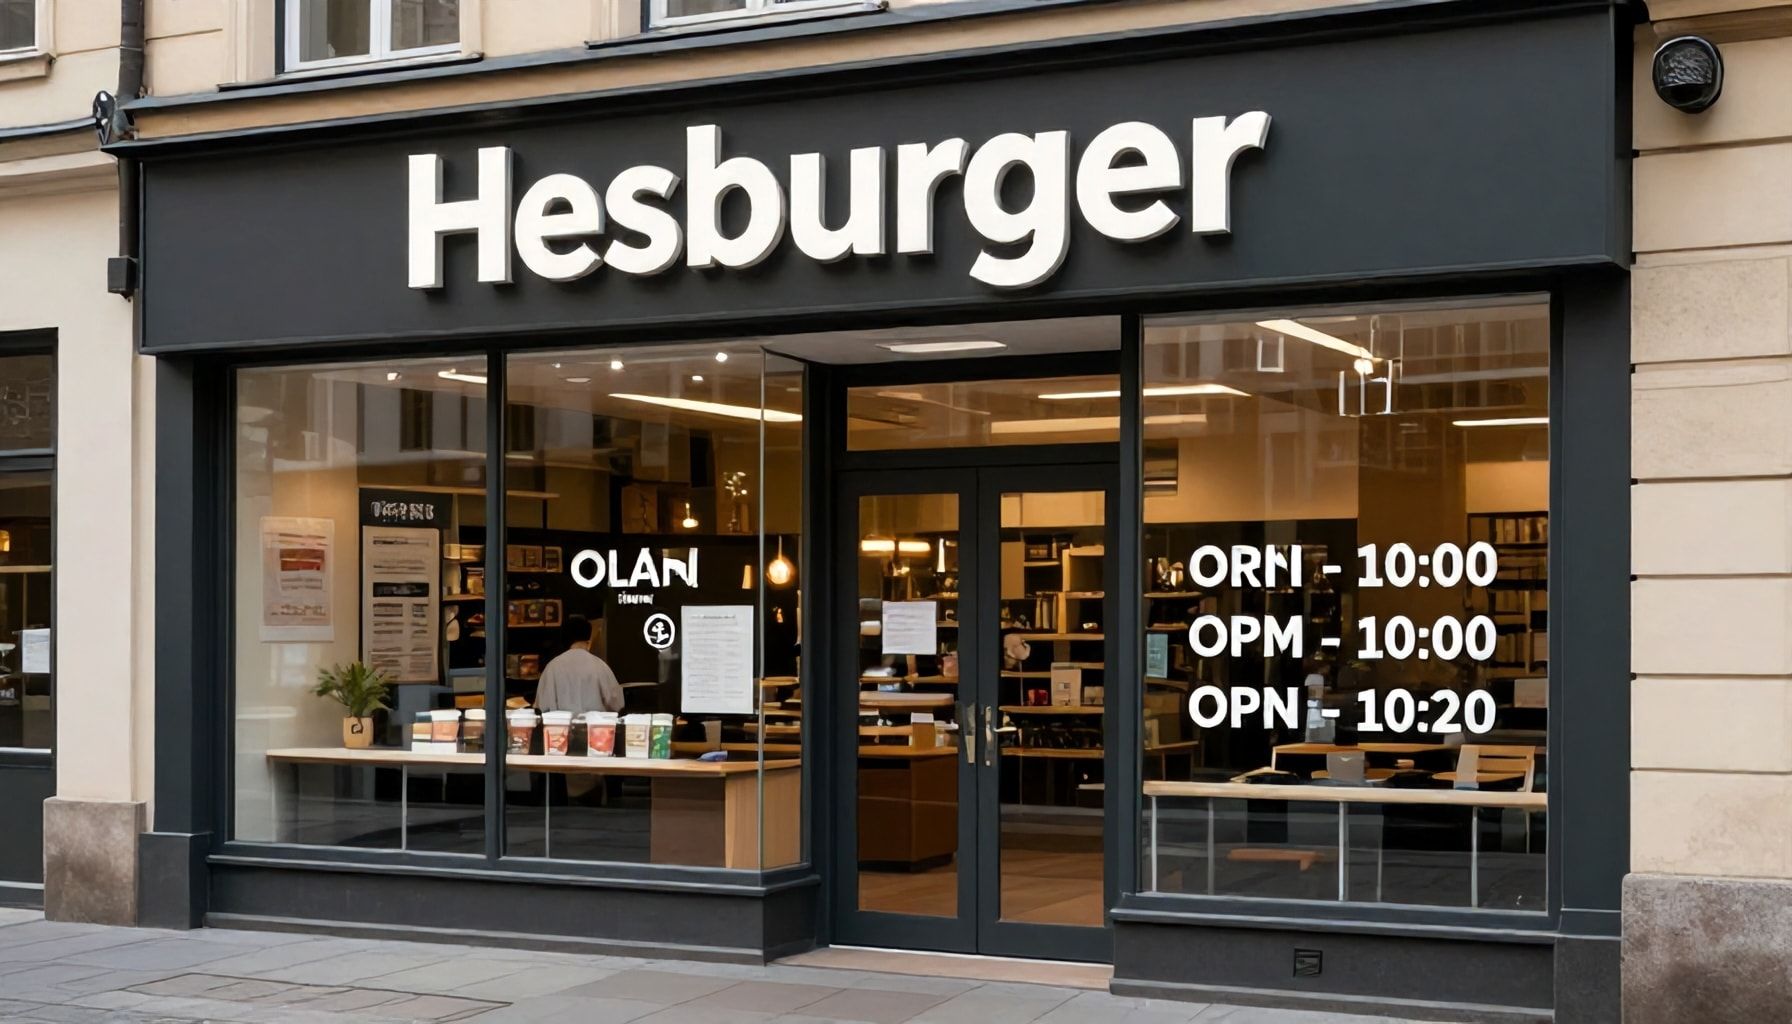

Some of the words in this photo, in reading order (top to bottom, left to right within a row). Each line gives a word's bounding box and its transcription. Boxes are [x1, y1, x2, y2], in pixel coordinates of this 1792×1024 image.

[407, 109, 1271, 289] Hesburger
[570, 547, 699, 589] OLAN
[1357, 541, 1498, 588] 10:00
[1188, 614, 1303, 659] OPM
[1357, 614, 1497, 661] 10:00
[1188, 685, 1299, 729] OPN
[1357, 688, 1496, 734] 10:20
